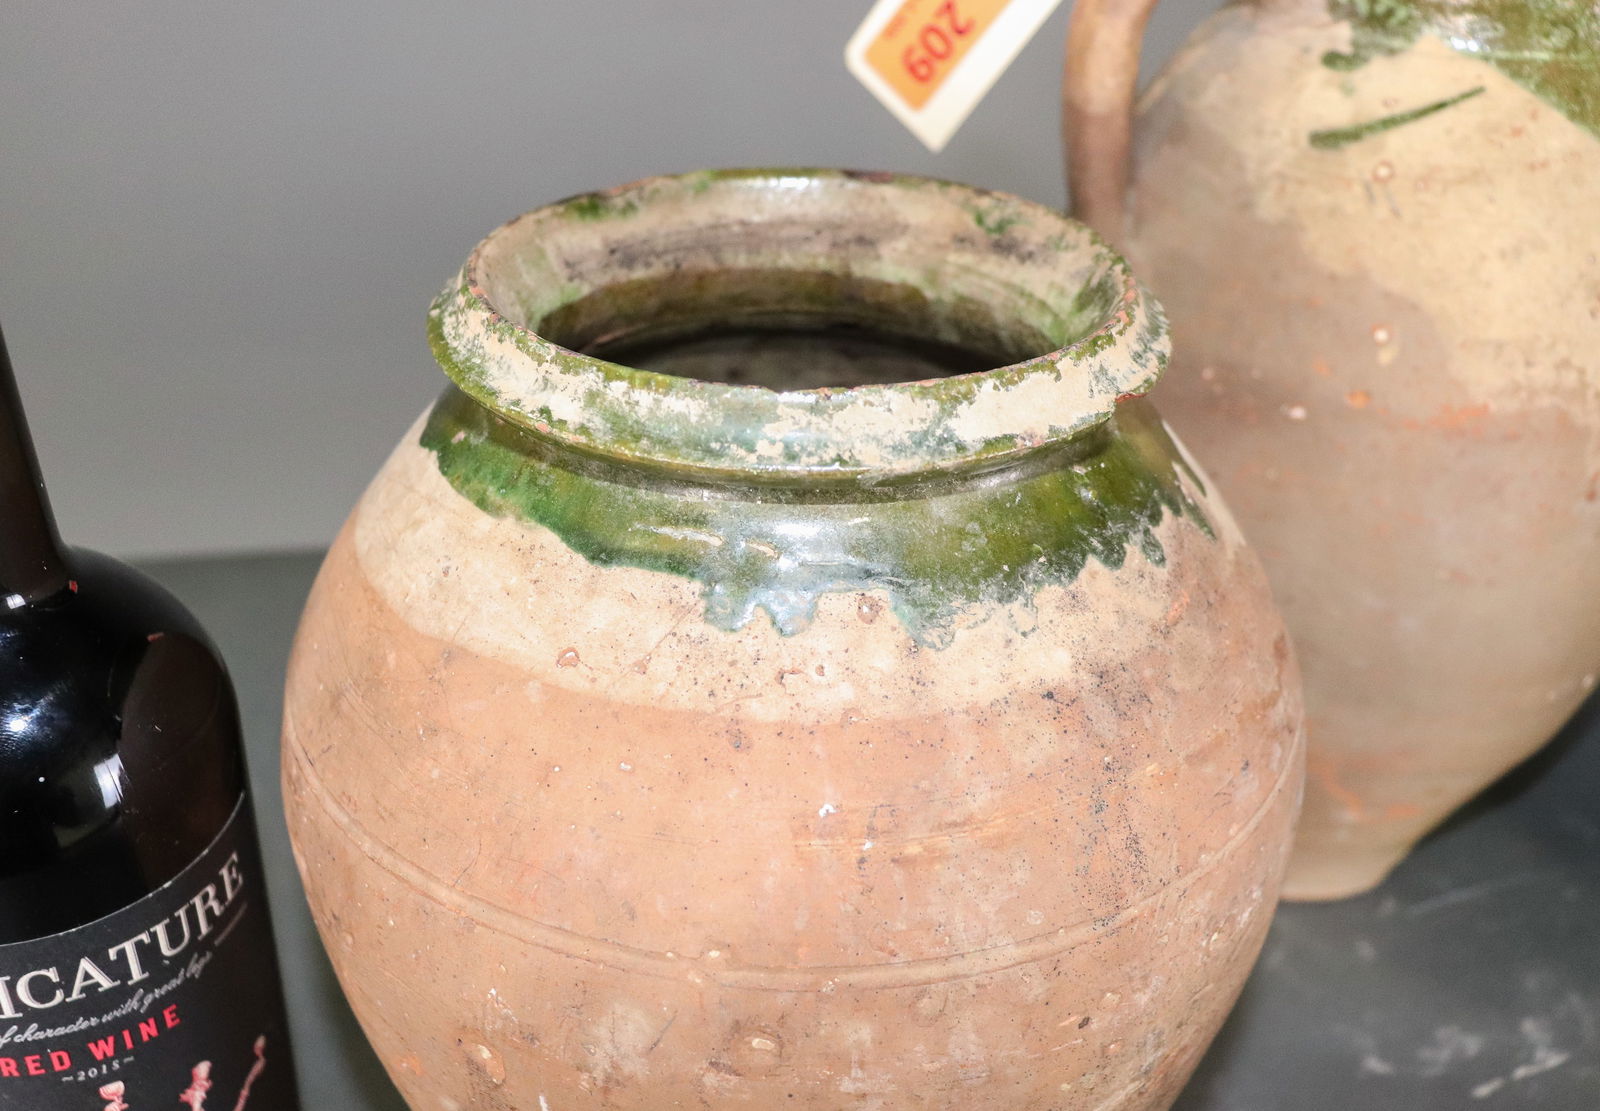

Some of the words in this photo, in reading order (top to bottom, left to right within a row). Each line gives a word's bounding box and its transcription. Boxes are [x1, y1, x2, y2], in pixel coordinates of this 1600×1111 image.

[902, 0, 976, 83] 209
[0, 1050, 72, 1078] RED
[87, 1003, 182, 1061] WINE
[13, 1017, 100, 1043] character
[101, 988, 146, 1024] with
[139, 968, 186, 1014] great
